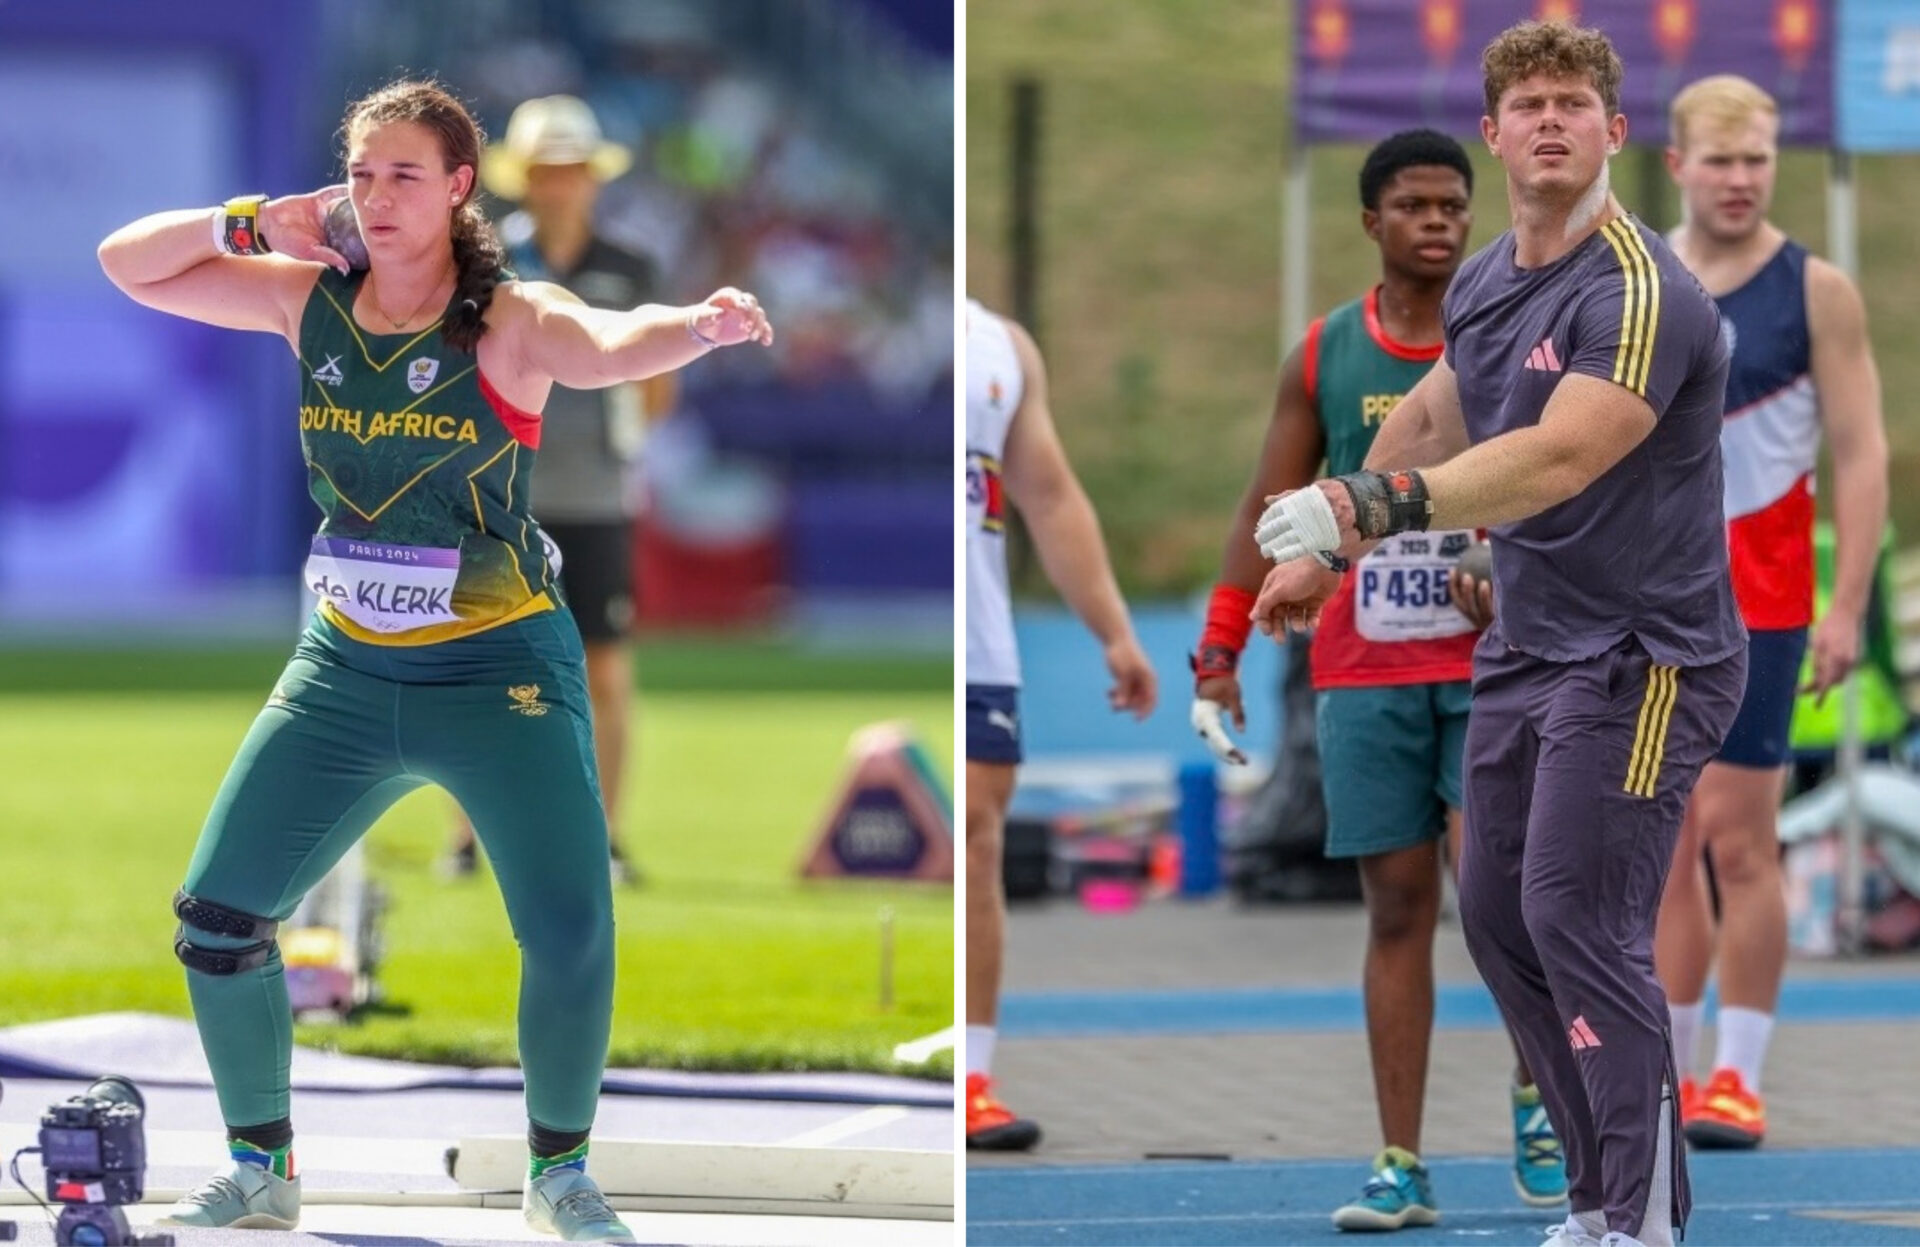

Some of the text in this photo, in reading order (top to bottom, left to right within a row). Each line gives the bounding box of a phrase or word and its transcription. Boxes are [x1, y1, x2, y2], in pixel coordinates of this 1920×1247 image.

[367, 411, 478, 444] AFRICA
[349, 544, 419, 561] PARIS 2024
[313, 575, 449, 615] de KLERK
[1363, 569, 1453, 608] P 435
